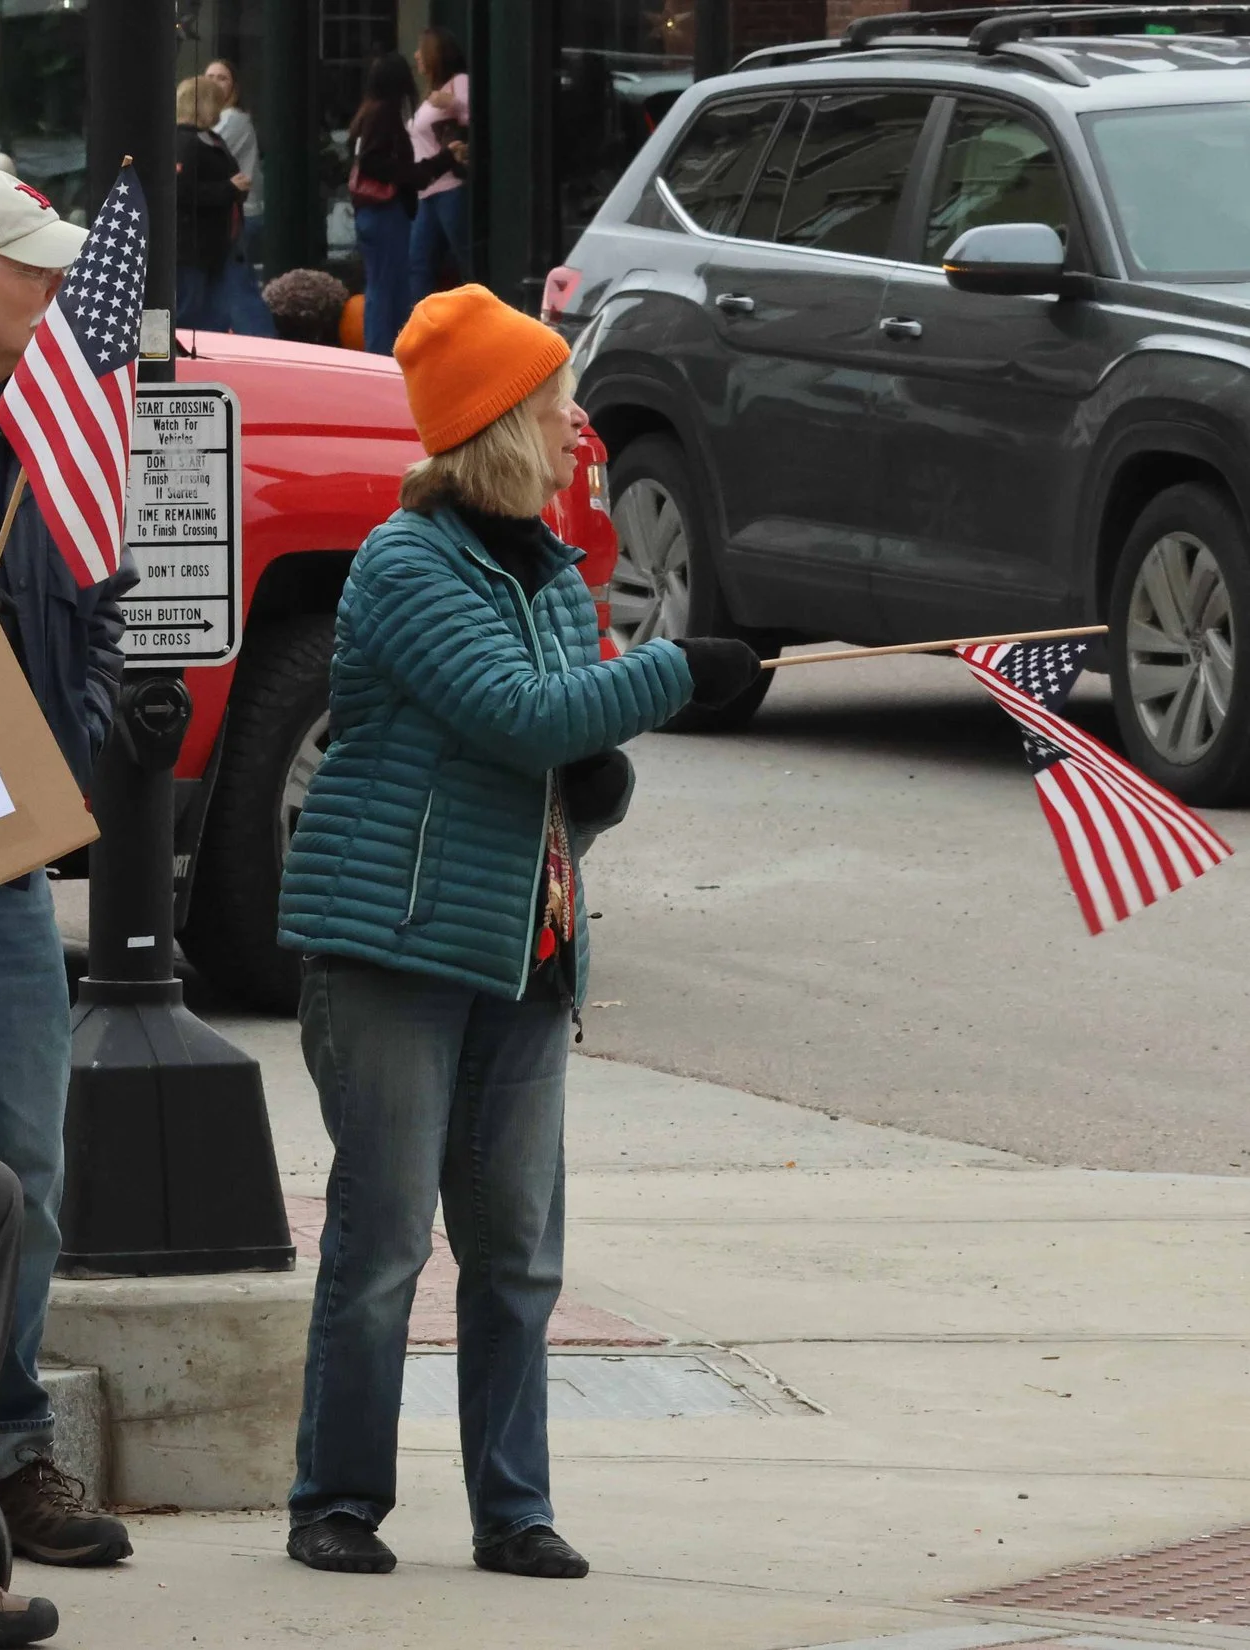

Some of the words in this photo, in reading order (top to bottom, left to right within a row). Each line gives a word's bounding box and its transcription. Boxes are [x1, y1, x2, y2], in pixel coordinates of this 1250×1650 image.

[137, 402, 163, 415] START
[170, 401, 215, 414] CROSSING
[153, 418, 179, 431] Watch
[185, 418, 198, 431] For
[144, 472, 169, 486] Finish
[138, 509, 159, 522] TIME
[165, 508, 217, 521] REMAINING
[138, 524, 147, 537] To
[153, 523, 177, 537] Finish
[183, 523, 217, 539] Crossing
[148, 565, 175, 578] DON'T
[181, 564, 209, 577] CROSS
[122, 609, 152, 621] PUSH
[158, 608, 201, 621] BUTTON
[132, 633, 147, 646] TO
[153, 632, 191, 646] CROSS
